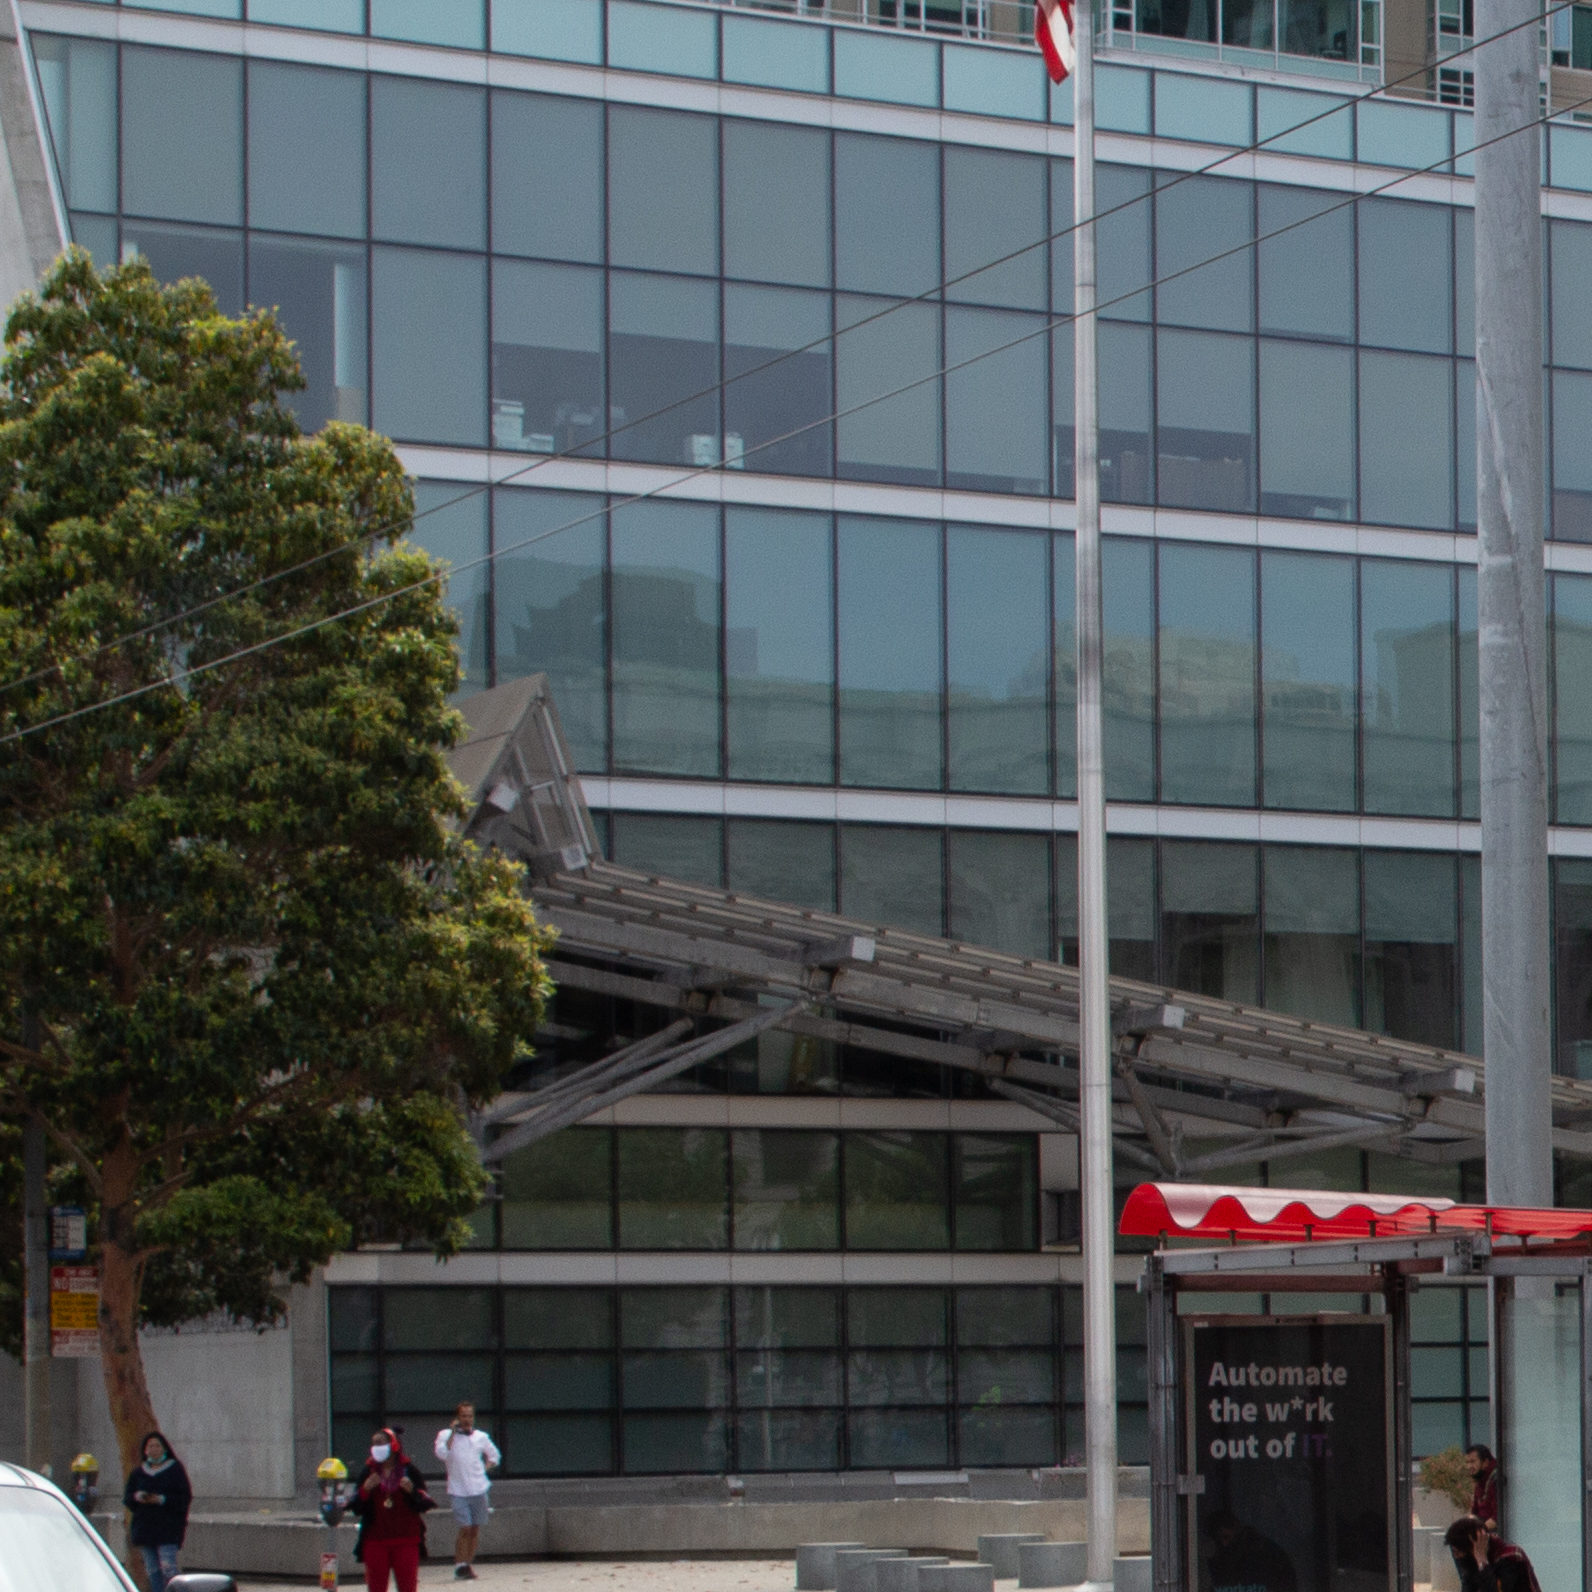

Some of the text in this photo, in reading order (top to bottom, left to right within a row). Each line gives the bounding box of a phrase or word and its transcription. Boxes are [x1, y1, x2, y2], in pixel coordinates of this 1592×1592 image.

[1208, 1361, 1348, 1387] Automate
[1209, 1396, 1258, 1423] the
[1210, 1432, 1332, 1459] out of IT.
